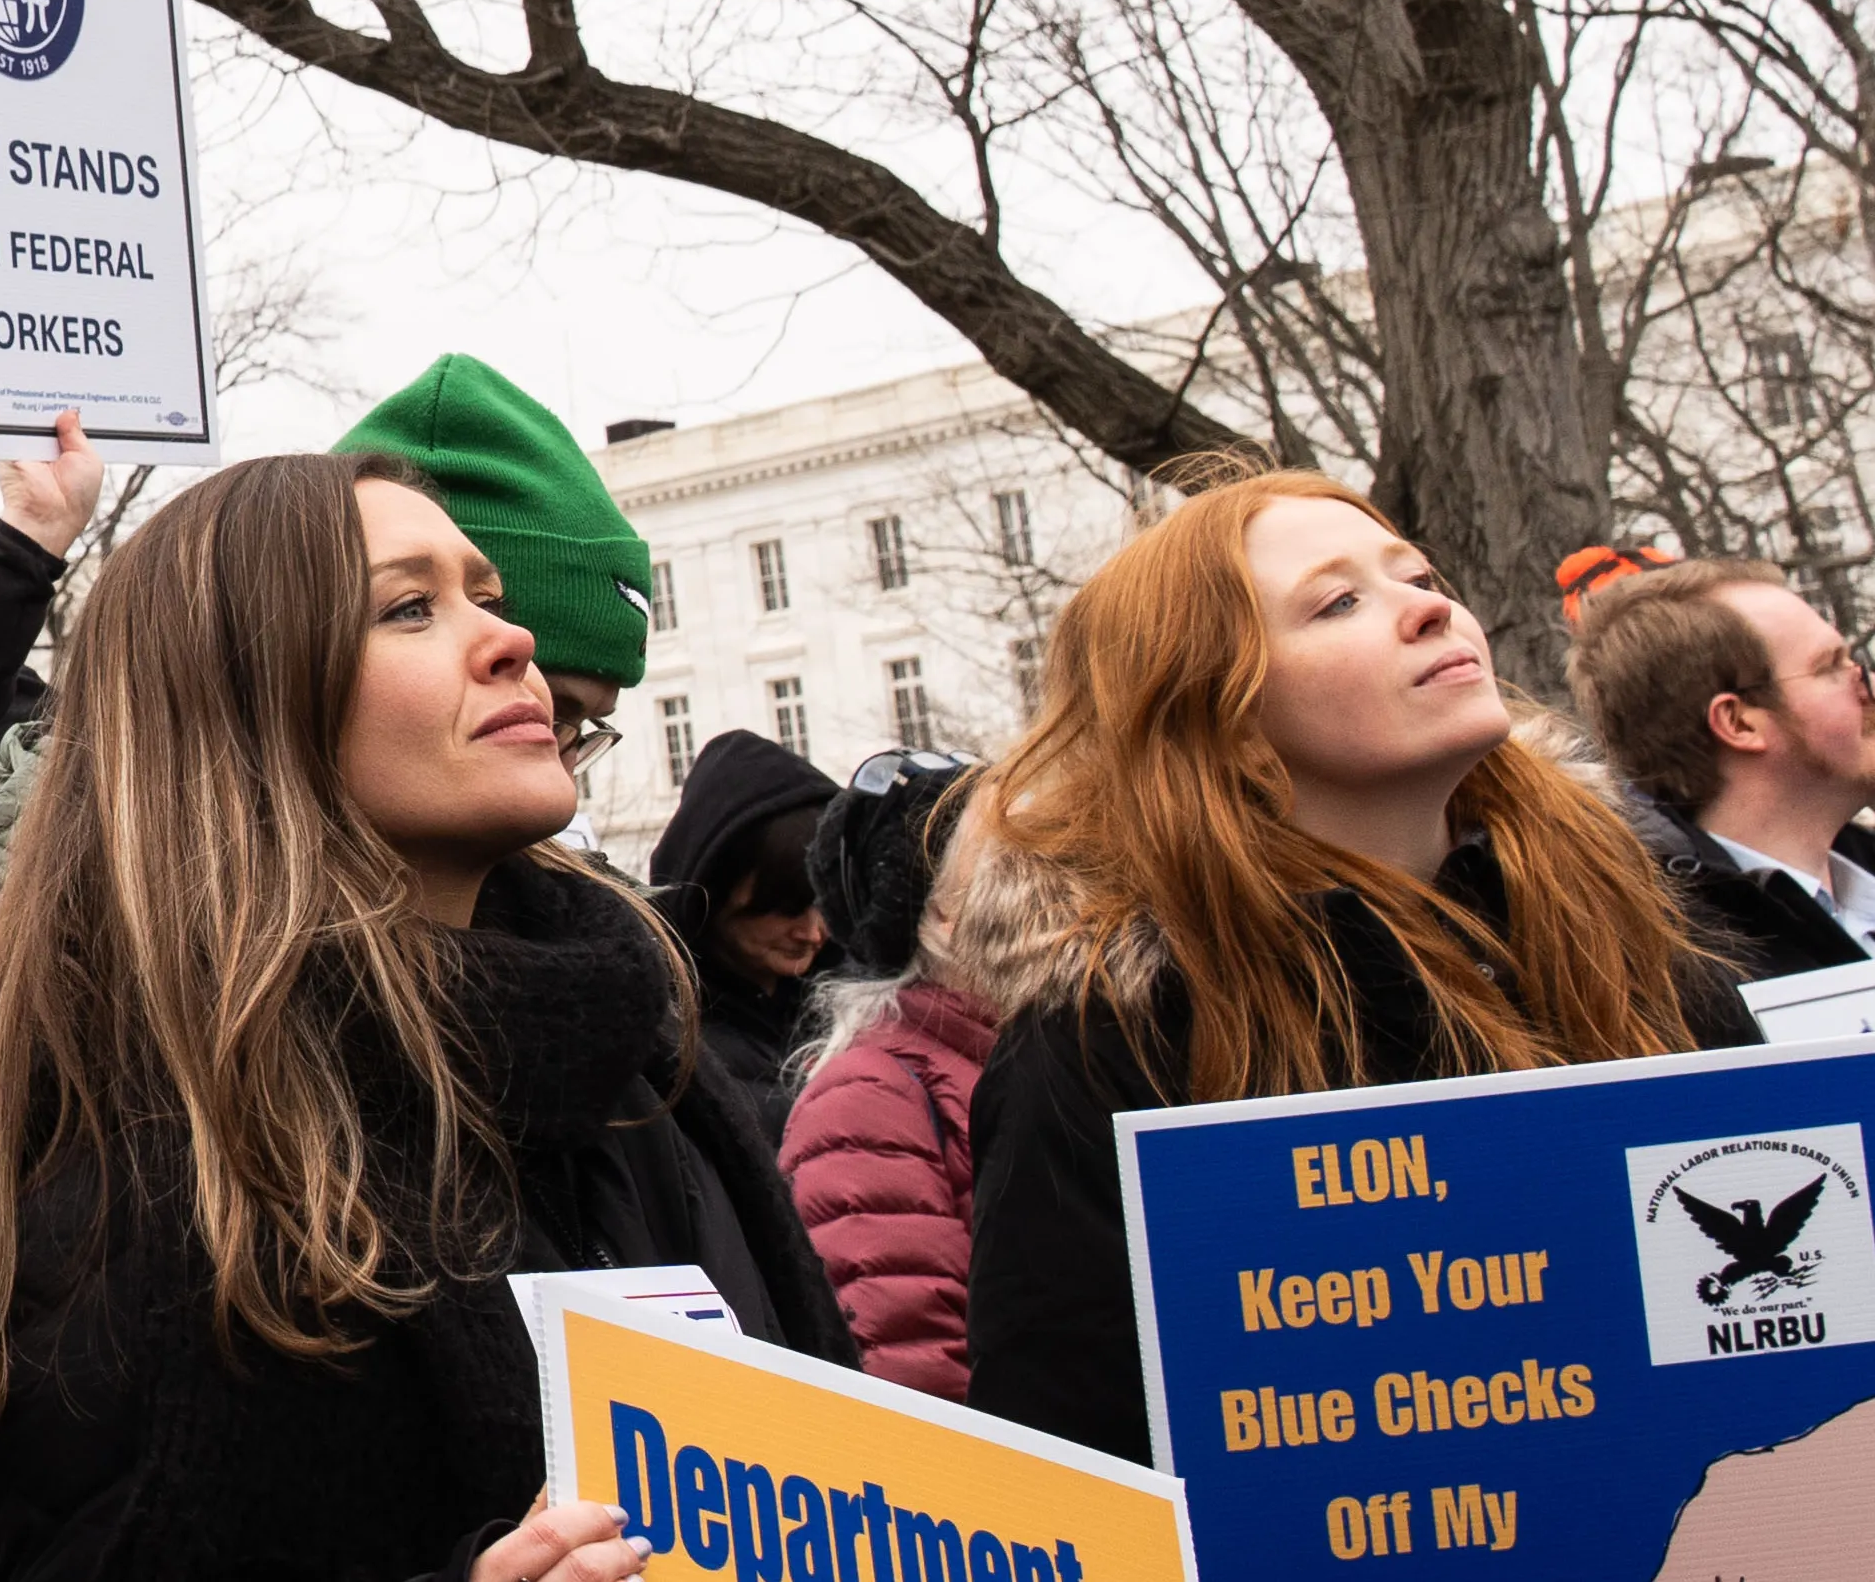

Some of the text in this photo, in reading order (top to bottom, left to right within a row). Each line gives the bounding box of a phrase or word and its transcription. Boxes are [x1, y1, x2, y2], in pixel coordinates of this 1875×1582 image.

[20, 54, 49, 75] 1918
[8, 139, 160, 199] STANDS
[10, 231, 154, 280] FEDERAL
[1291, 1134, 1448, 1208] ELON,
[1646, 1140, 1859, 1223] NATIONAL LABOR RELATIONS BOARD UNION
[1799, 1249, 1826, 1262] U.S.
[1237, 1248, 1549, 1332] Keep Your
[1741, 1304, 1757, 1315] do
[1759, 1302, 1780, 1313] our
[1707, 1312, 1826, 1355] NLRBU
[1219, 1358, 1596, 1452] Blue Checks
[1326, 1483, 1519, 1561] Off My
